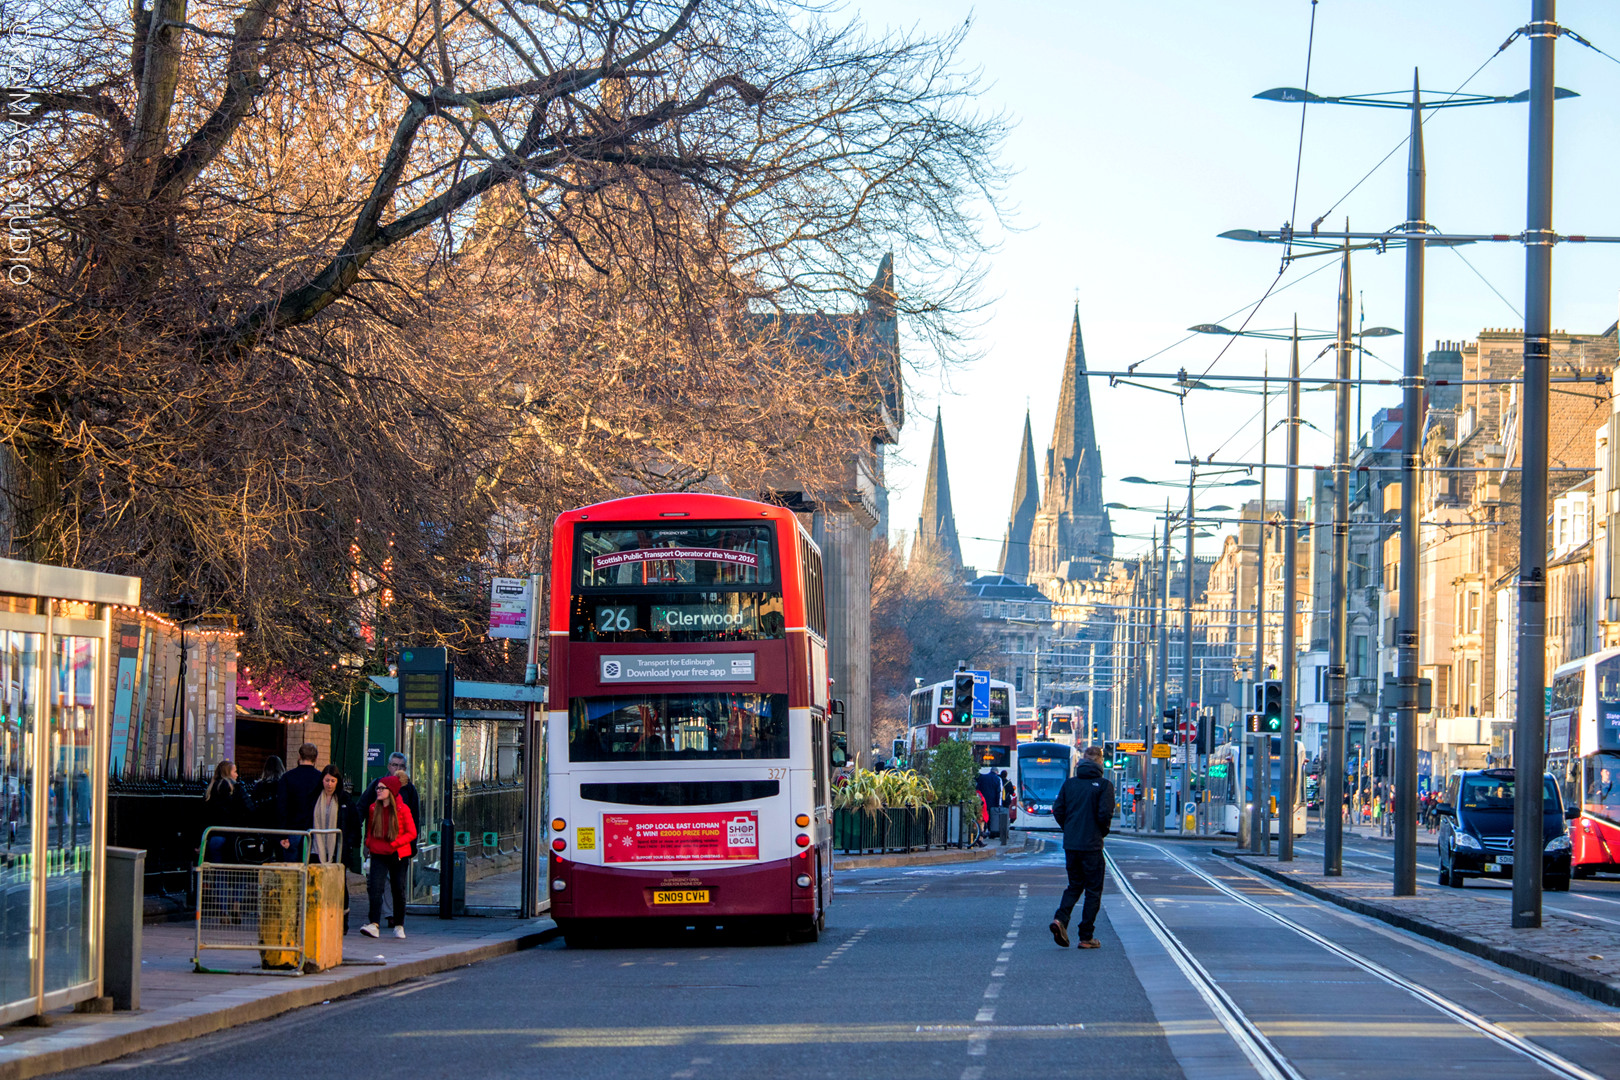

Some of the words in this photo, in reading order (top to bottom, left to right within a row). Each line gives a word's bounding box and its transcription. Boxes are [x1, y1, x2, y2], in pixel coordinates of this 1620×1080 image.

[597, 556, 622, 566] Scottish
[623, 552, 643, 561] Public
[643, 550, 674, 558] Transport
[738, 554, 755, 563] 2016
[601, 608, 631, 631] 26
[666, 610, 743, 626] Clerwood
[627, 668, 669, 677] Download
[671, 669, 690, 678] your
[692, 668, 708, 676] free
[768, 768, 786, 779] 327
[658, 892, 683, 902] SN09
[686, 892, 705, 901] CVH
